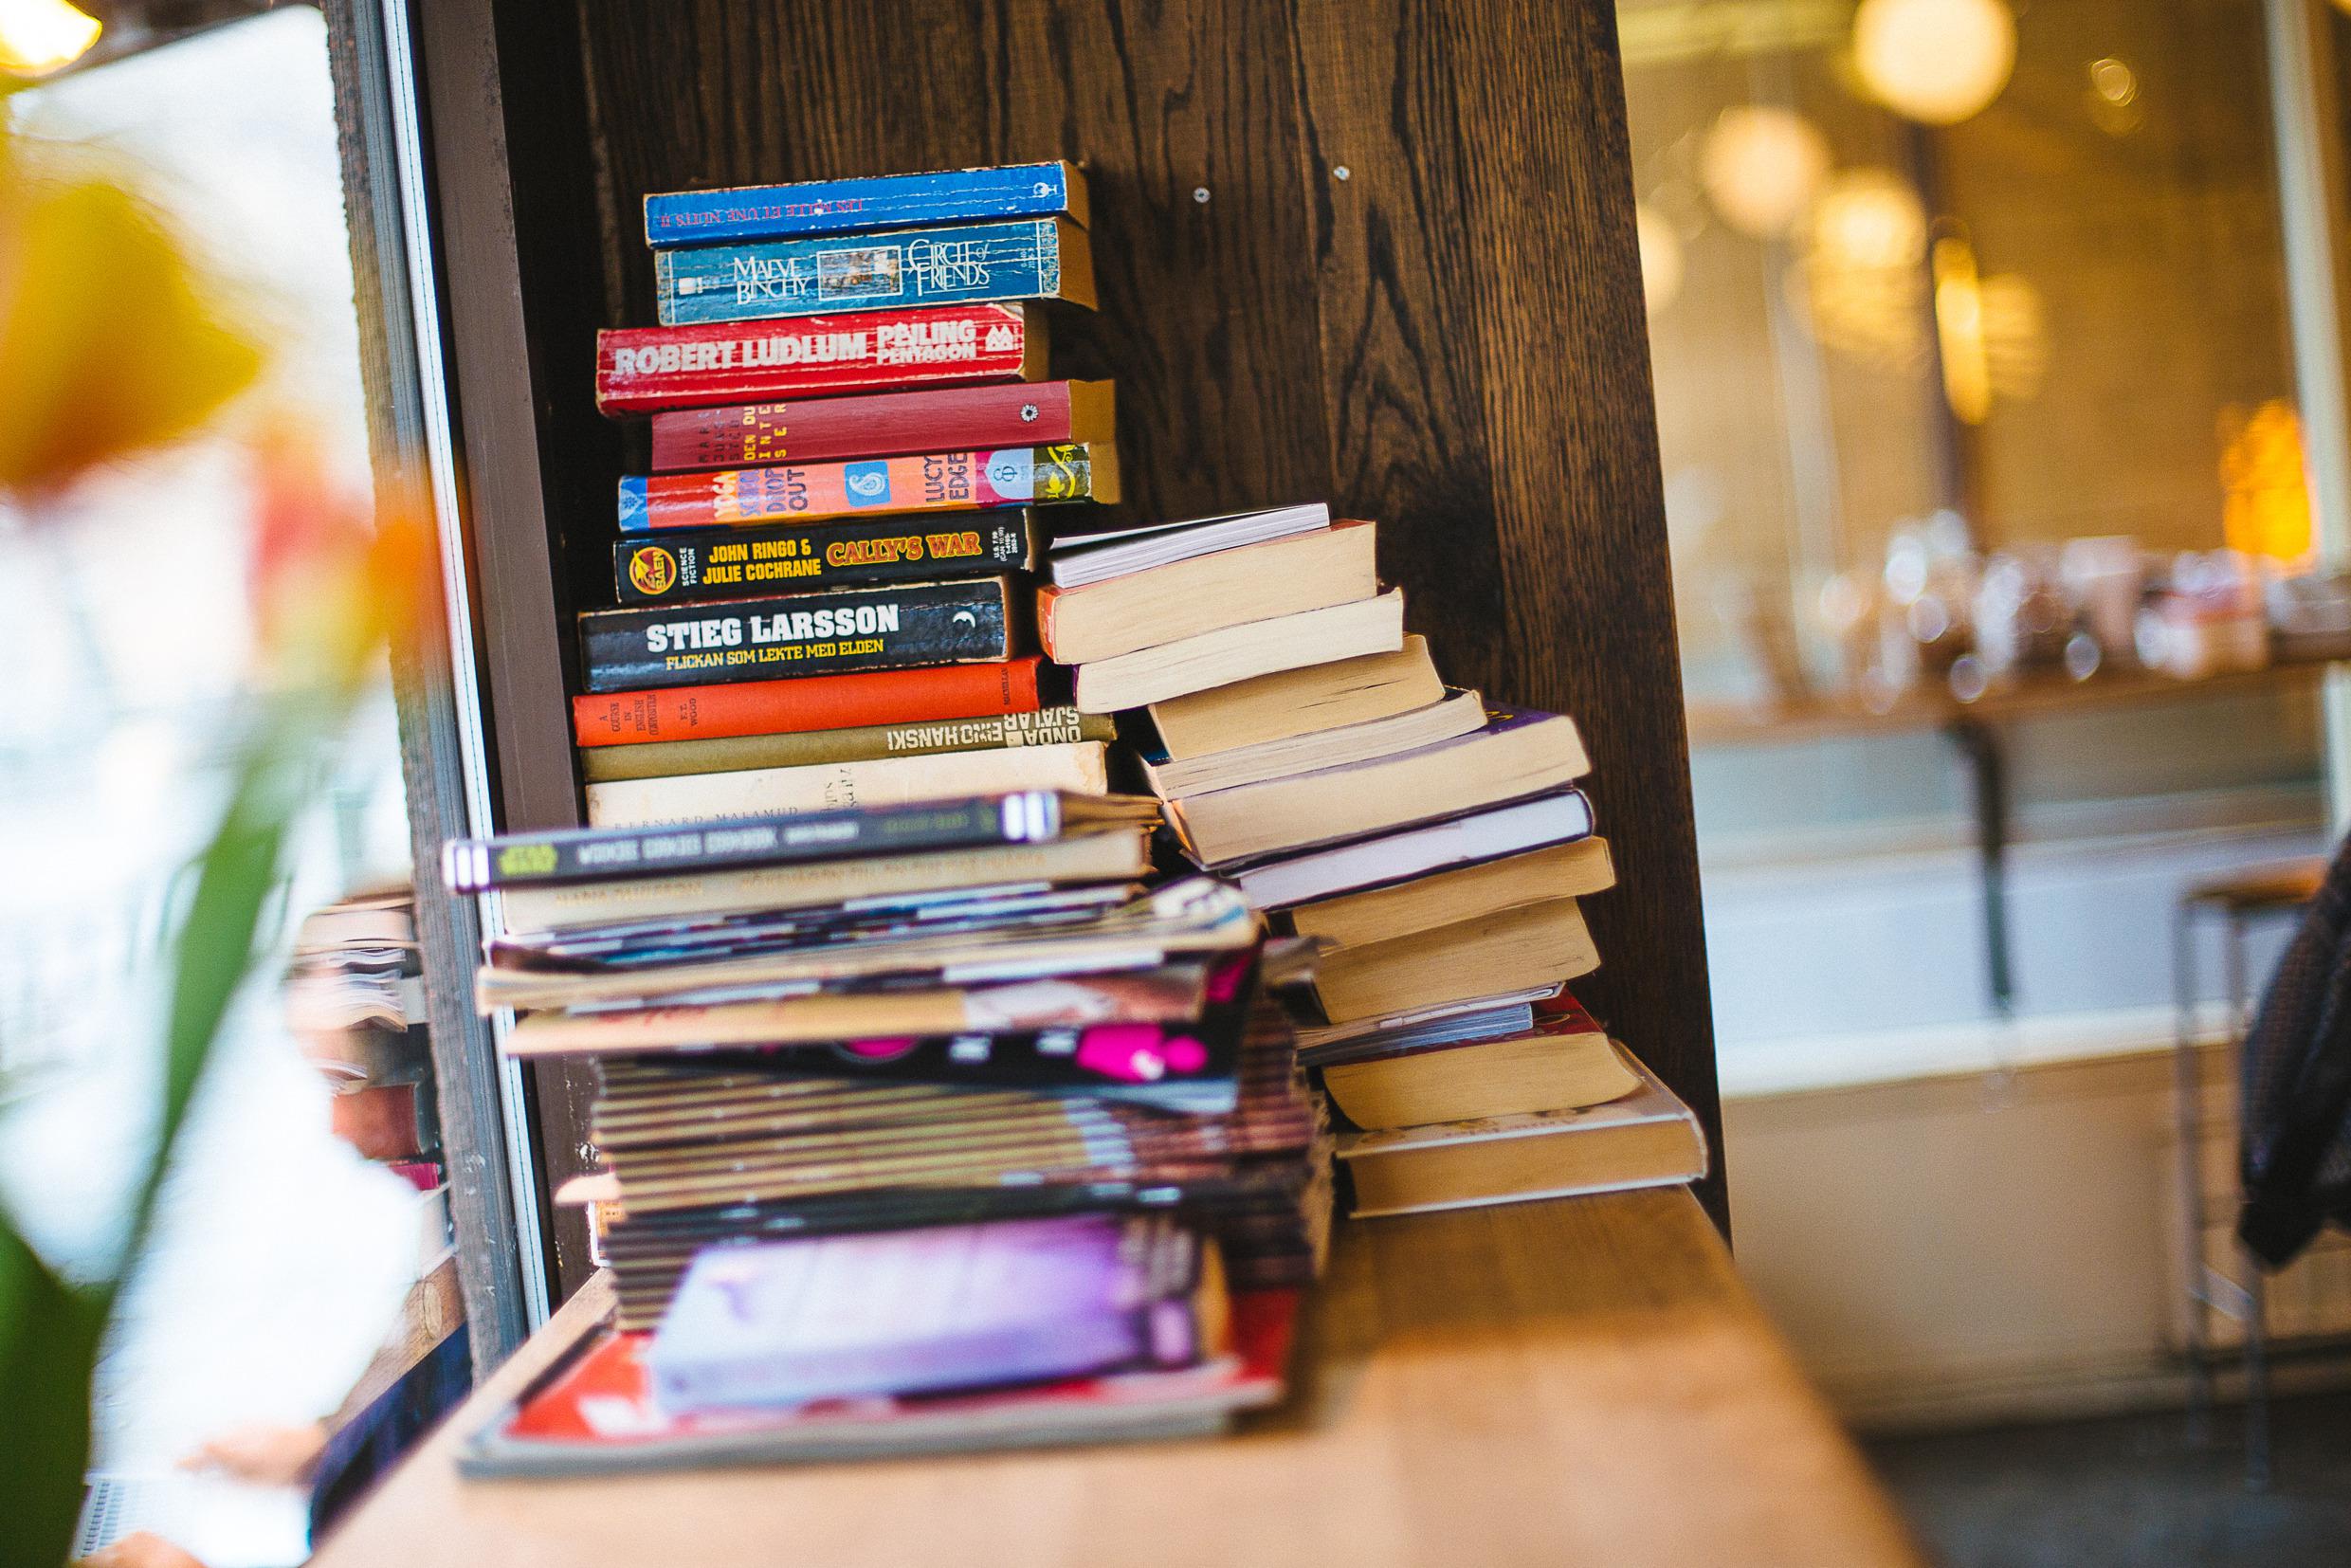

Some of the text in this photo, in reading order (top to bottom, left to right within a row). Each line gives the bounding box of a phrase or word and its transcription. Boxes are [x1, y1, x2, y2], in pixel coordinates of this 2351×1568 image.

[727, 208, 758, 221] UNE
[764, 207, 781, 218] ET
[908, 239, 972, 271] CIRCLE
[737, 277, 811, 304] BINCHY
[917, 263, 990, 297] FRIENDS
[615, 332, 867, 374] ROBERT LUDLUM
[877, 342, 976, 364] PENTAGON
[742, 406, 756, 461] DEN DU
[758, 406, 772, 458] INTE
[774, 404, 787, 458] SER
[766, 467, 786, 513] DROP
[788, 469, 808, 511] OUT
[924, 456, 945, 502] LUCY
[948, 453, 968, 501] EDGE
[713, 473, 737, 518] YOGA
[679, 547, 689, 586] SCIENCE
[688, 548, 697, 584] FICTION
[709, 538, 811, 563] JOHN RINGO &
[827, 531, 982, 567] CALLY'S WAR
[702, 558, 821, 585] JULIE COCHRANE
[647, 604, 900, 652] STIEG LARSSON
[665, 638, 884, 671] FLICKAN SOM LEKTE MED ELDEN
[887, 724, 957, 751] HANSKI
[1025, 725, 1082, 746] ONDA
